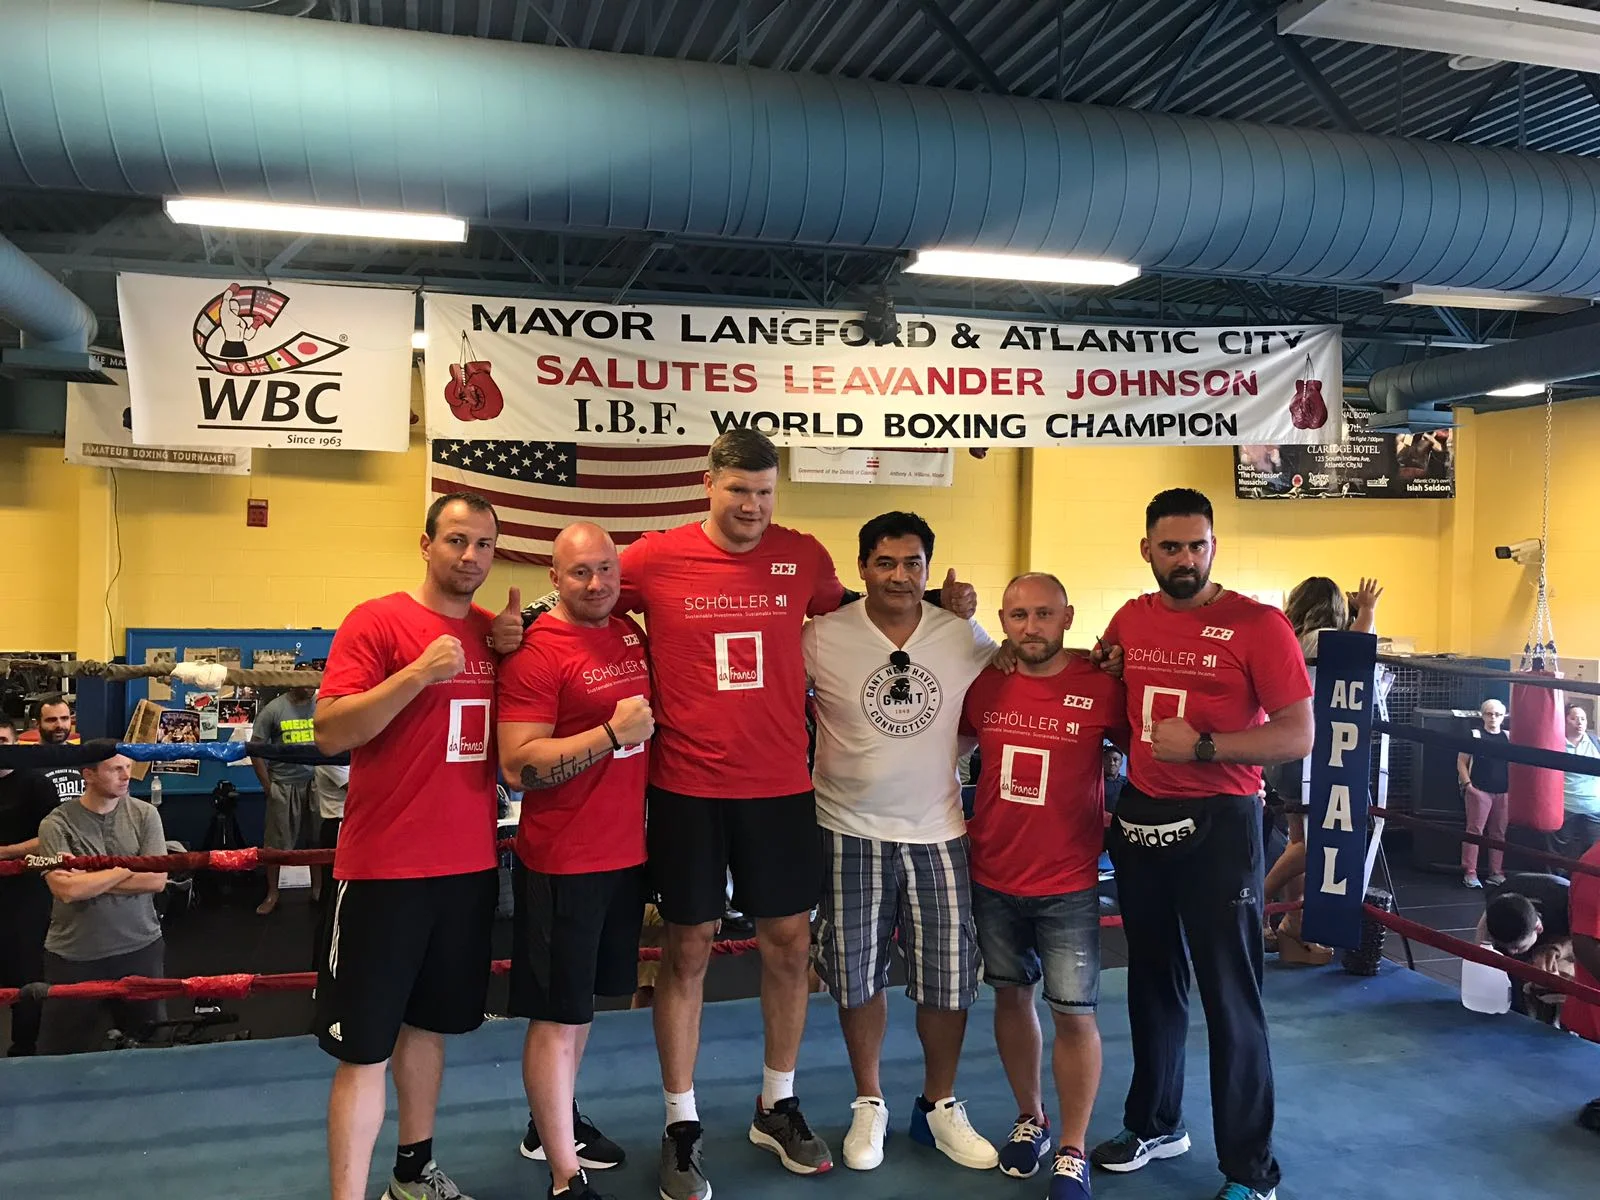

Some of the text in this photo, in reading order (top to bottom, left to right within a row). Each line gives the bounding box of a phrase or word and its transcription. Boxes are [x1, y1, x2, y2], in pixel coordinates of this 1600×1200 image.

[472, 304, 655, 341] MAYOR
[951, 322, 980, 349] &
[1000, 326, 1199, 355] ATLANTIC
[1218, 330, 1305, 356] CITY
[537, 355, 1258, 399] SALUTES LEAVANDER JOHNSON
[199, 377, 341, 425] WBC
[574, 398, 1238, 439] I.B.F. WORLD BOXING CHAMPION
[287, 434, 342, 447] Since 1963
[1307, 445, 1380, 454] CLARIDGE HOTEL
[85, 445, 235, 465] AMATEUR BOXING TOURNAMENT
[771, 563, 797, 575] ECB
[684, 594, 769, 611] SCHÖLLER
[1200, 625, 1235, 641] ECB
[1127, 647, 1196, 666] SCHÖLLER
[583, 660, 640, 685] SCHÖLLER
[719, 666, 757, 681] da Franco
[866, 673, 884, 698] GANT
[912, 667, 938, 694] HAVEN
[1063, 694, 1094, 710] ECB
[1330, 680, 1363, 711] AC
[870, 705, 935, 734] CONNECTICUT
[983, 711, 1059, 732] SCHÖLLER
[449, 735, 484, 752] da Franco
[1011, 778, 1039, 797] Franco
